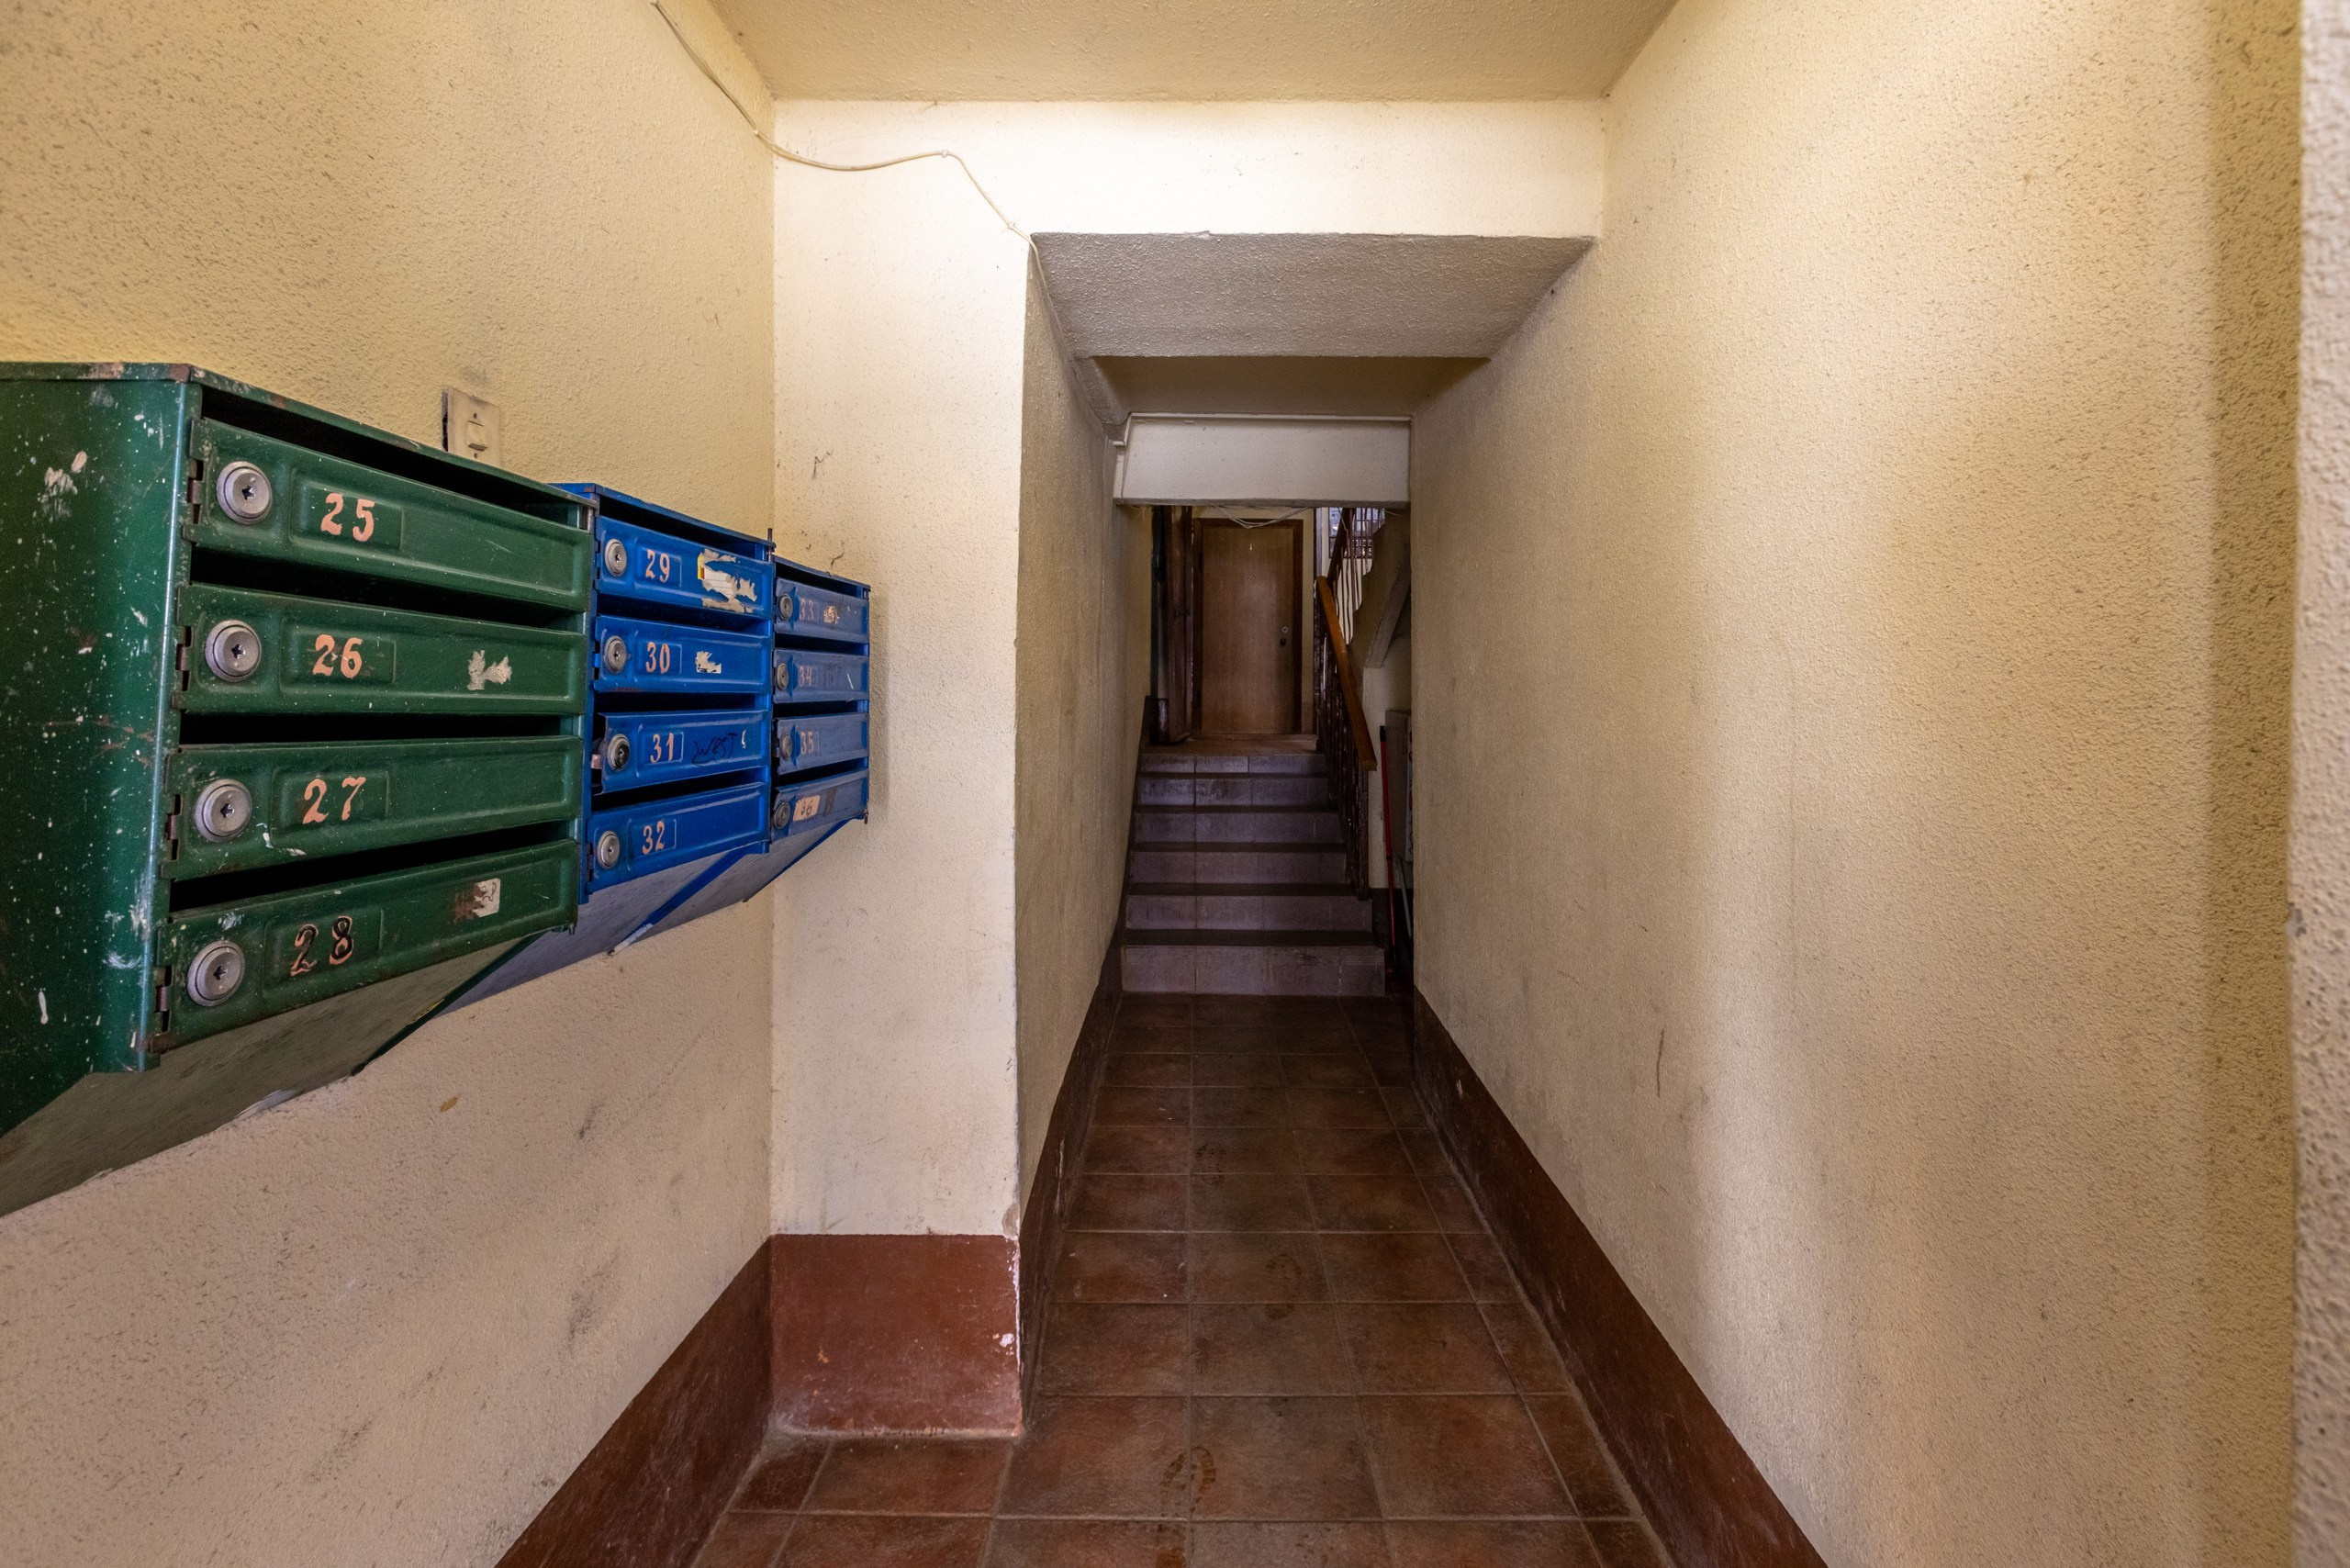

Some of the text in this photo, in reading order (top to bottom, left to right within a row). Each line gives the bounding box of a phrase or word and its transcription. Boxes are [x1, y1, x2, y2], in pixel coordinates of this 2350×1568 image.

[320, 492, 375, 543] 25
[645, 549, 670, 584] 29
[800, 598, 815, 622] 33
[312, 634, 363, 679] 26
[645, 642, 670, 675] 30
[799, 665, 812, 688] 34
[650, 733, 674, 764] 31
[800, 731, 814, 755] 35
[302, 775, 366, 824] 27
[642, 820, 666, 856] 32
[290, 915, 355, 977] 28
